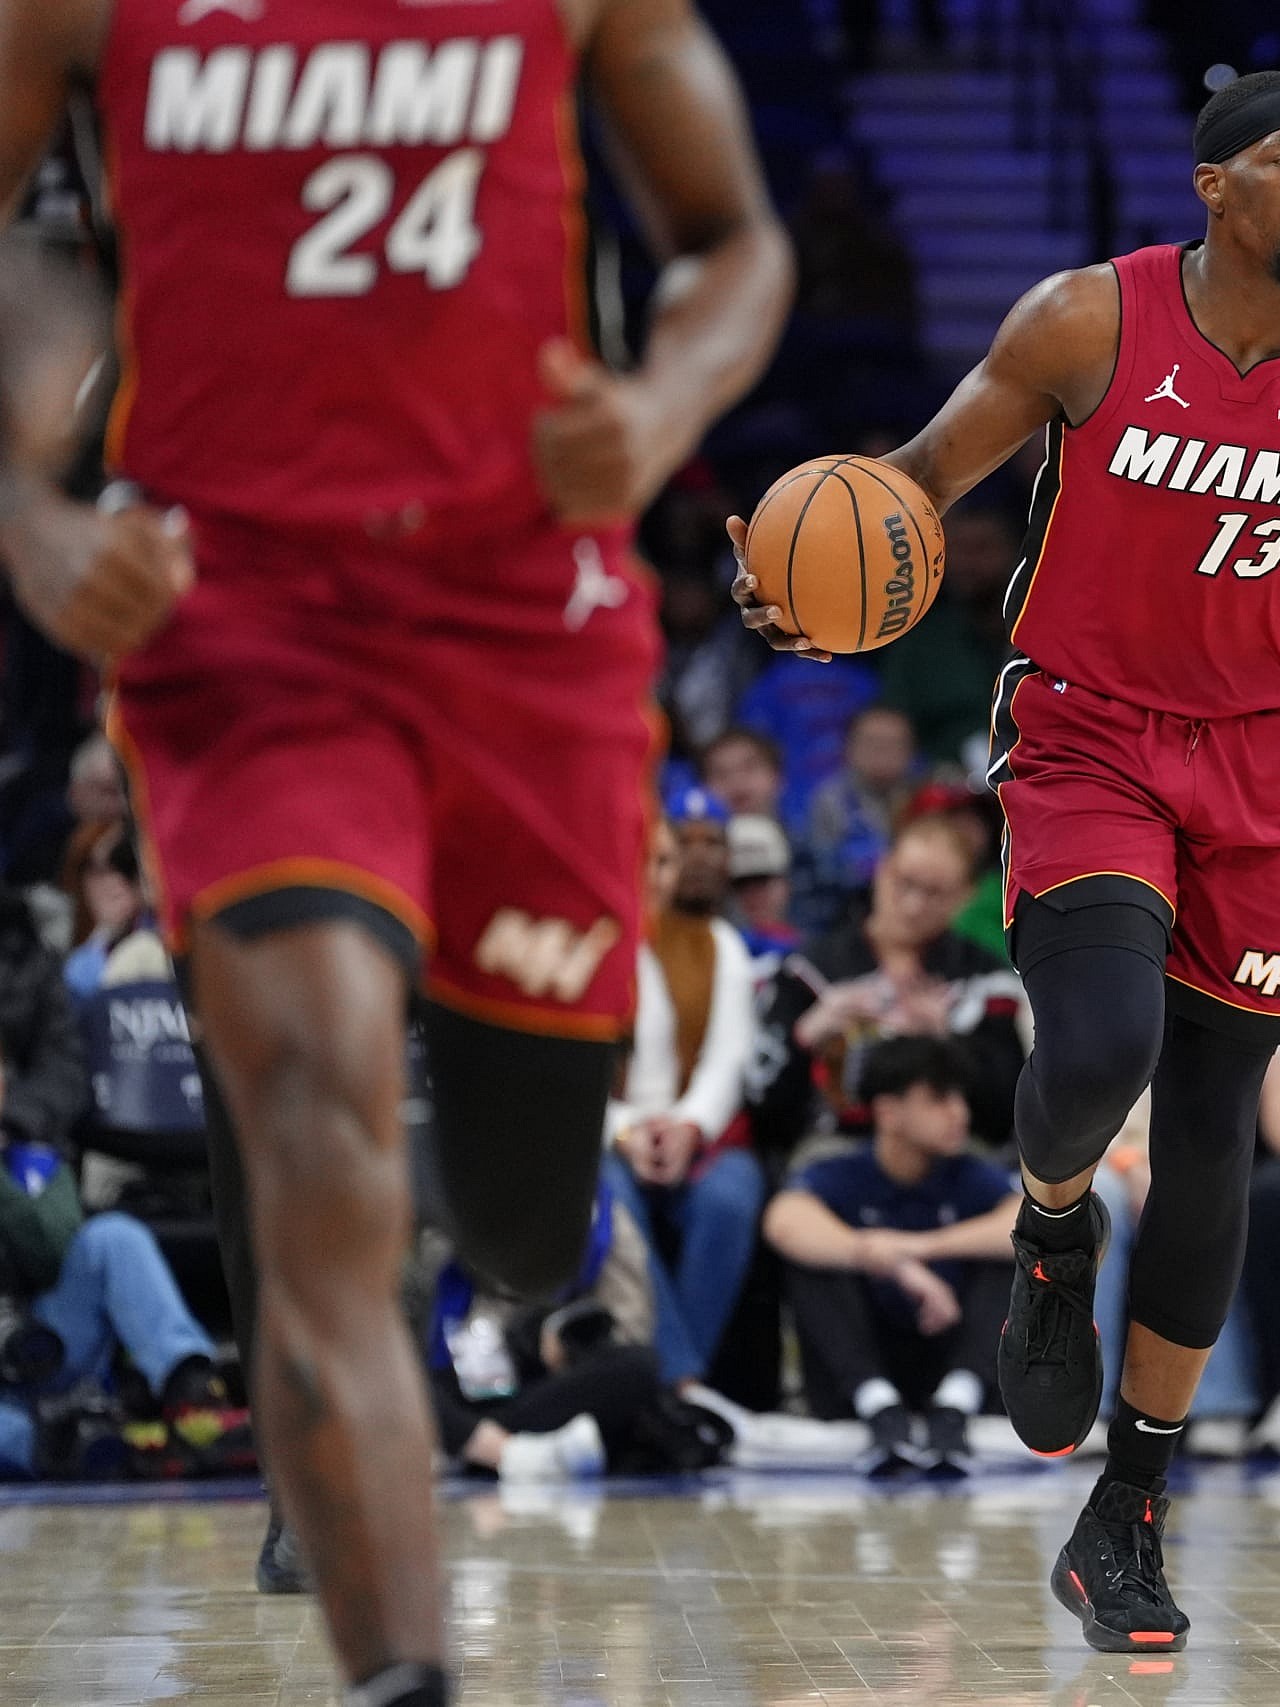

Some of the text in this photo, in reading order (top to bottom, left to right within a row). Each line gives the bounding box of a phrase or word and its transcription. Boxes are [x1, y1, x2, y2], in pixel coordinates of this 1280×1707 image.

[143, 34, 524, 154] MIAMI
[285, 146, 487, 297] 24
[875, 513, 914, 638] Wilson
